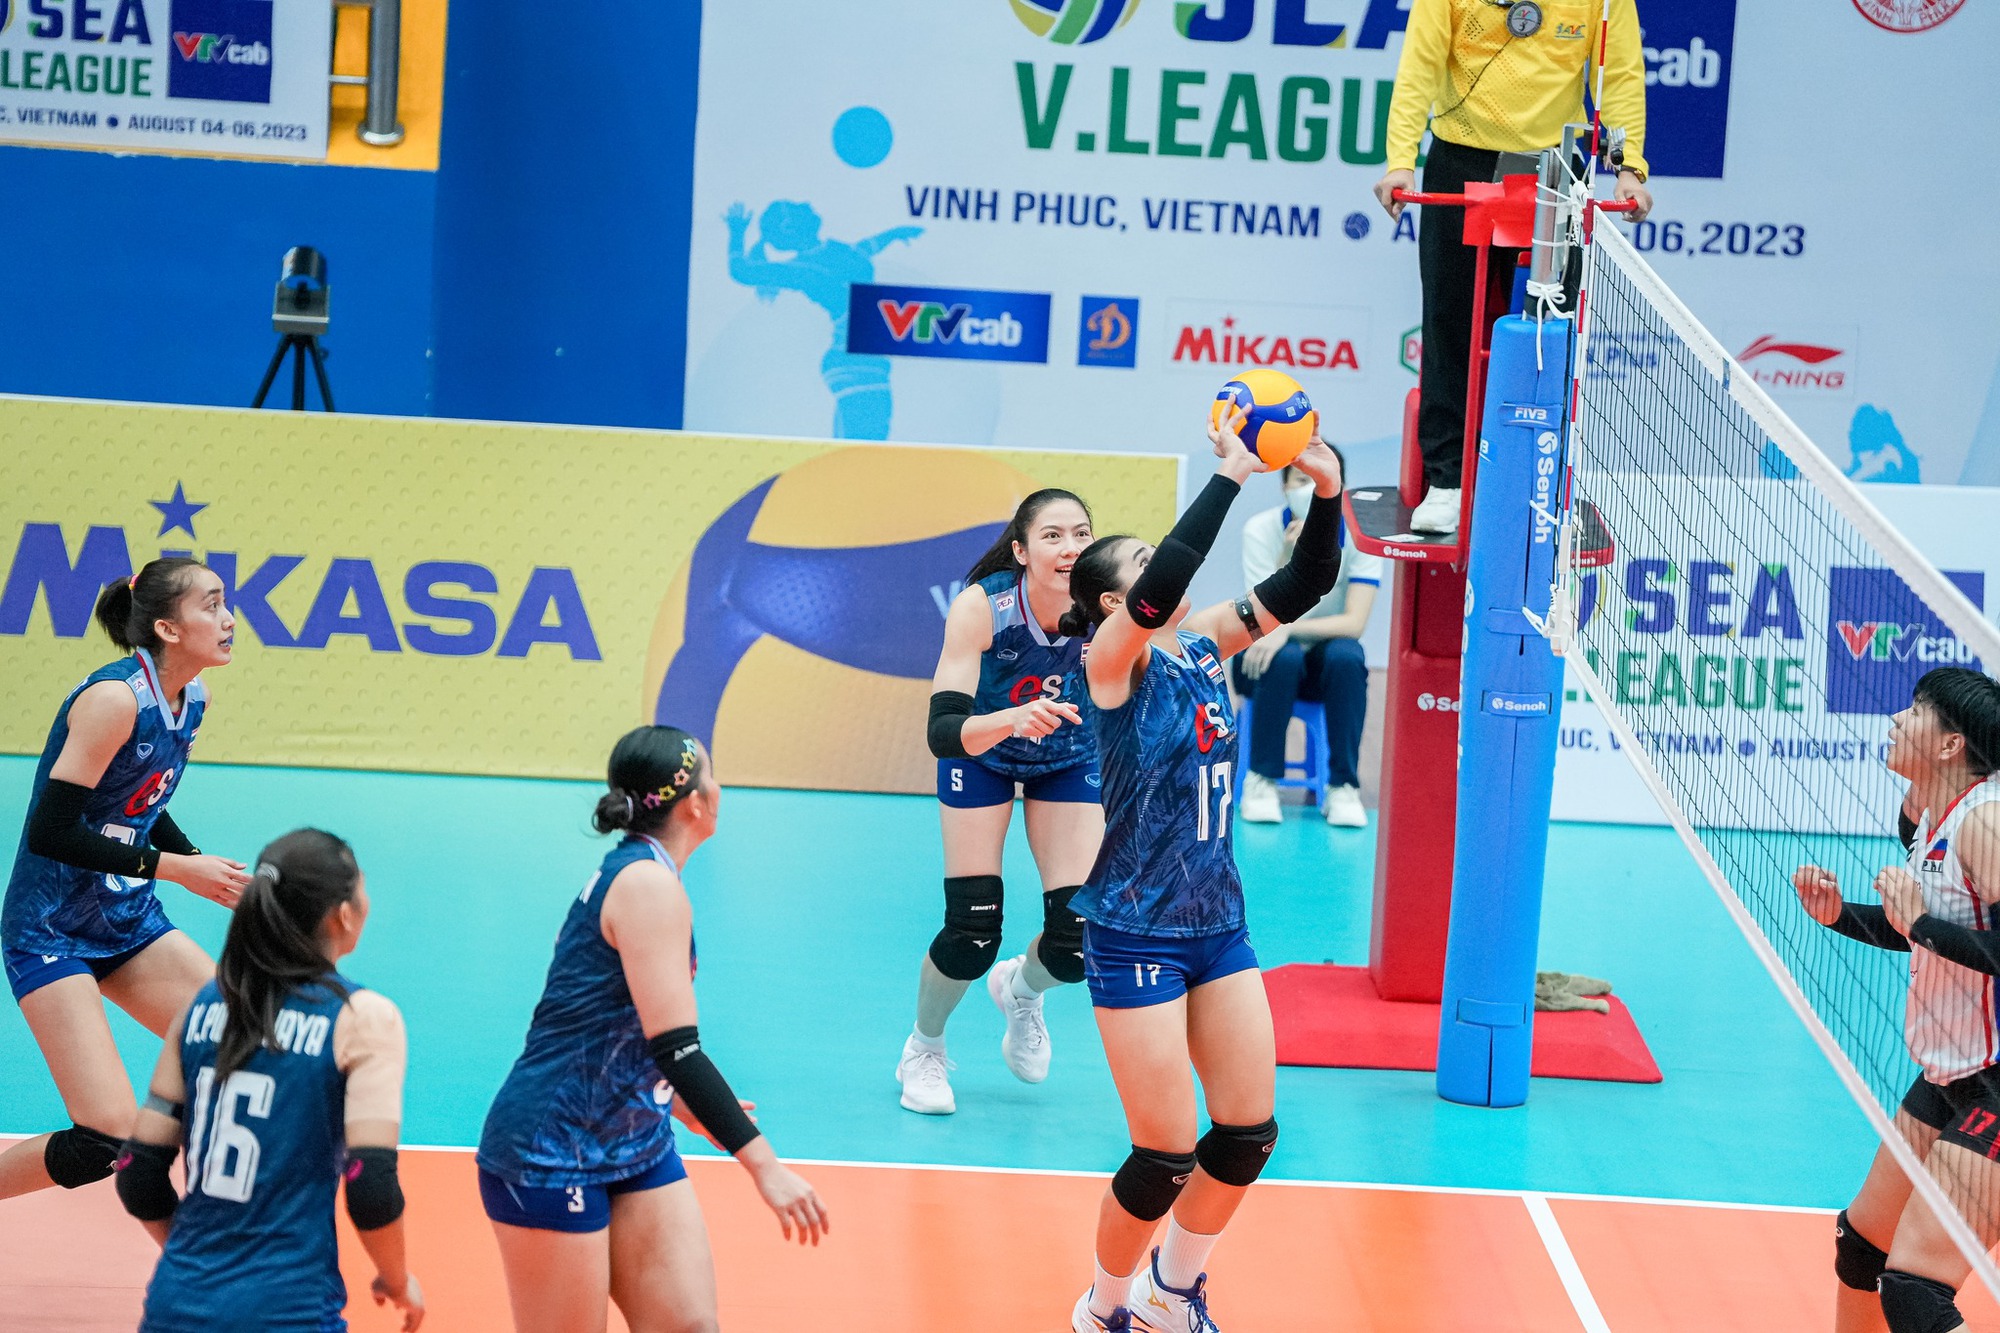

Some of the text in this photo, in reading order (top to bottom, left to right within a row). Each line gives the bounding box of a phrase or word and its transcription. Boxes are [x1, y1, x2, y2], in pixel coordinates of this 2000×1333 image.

[28, 0, 152, 45] SEA
[1643, 36, 1721, 88] cab
[17, 107, 97, 126] VIETNAM
[128, 114, 197, 134] AUGUST
[1014, 61, 1428, 168] V.LEAGU
[905, 184, 1321, 238] VINH PHUC, VIETNAM
[1753, 370, 1846, 389] I-NING
[1515, 407, 1547, 420] FIVB
[1535, 456, 1555, 544] Senoh
[1391, 547, 1428, 559] Senoh
[0, 521, 604, 662] MKASA
[997, 598, 1013, 609] PEA
[1625, 558, 1805, 640] SEA
[1504, 700, 1546, 711] Senoh
[1770, 738, 1868, 762] AUGUST
[1197, 761, 1232, 841] 17
[1134, 963, 1160, 987] 17
[186, 1066, 276, 1203] 16
[1958, 1106, 1998, 1137] 17
[565, 1185, 584, 1212] 3
